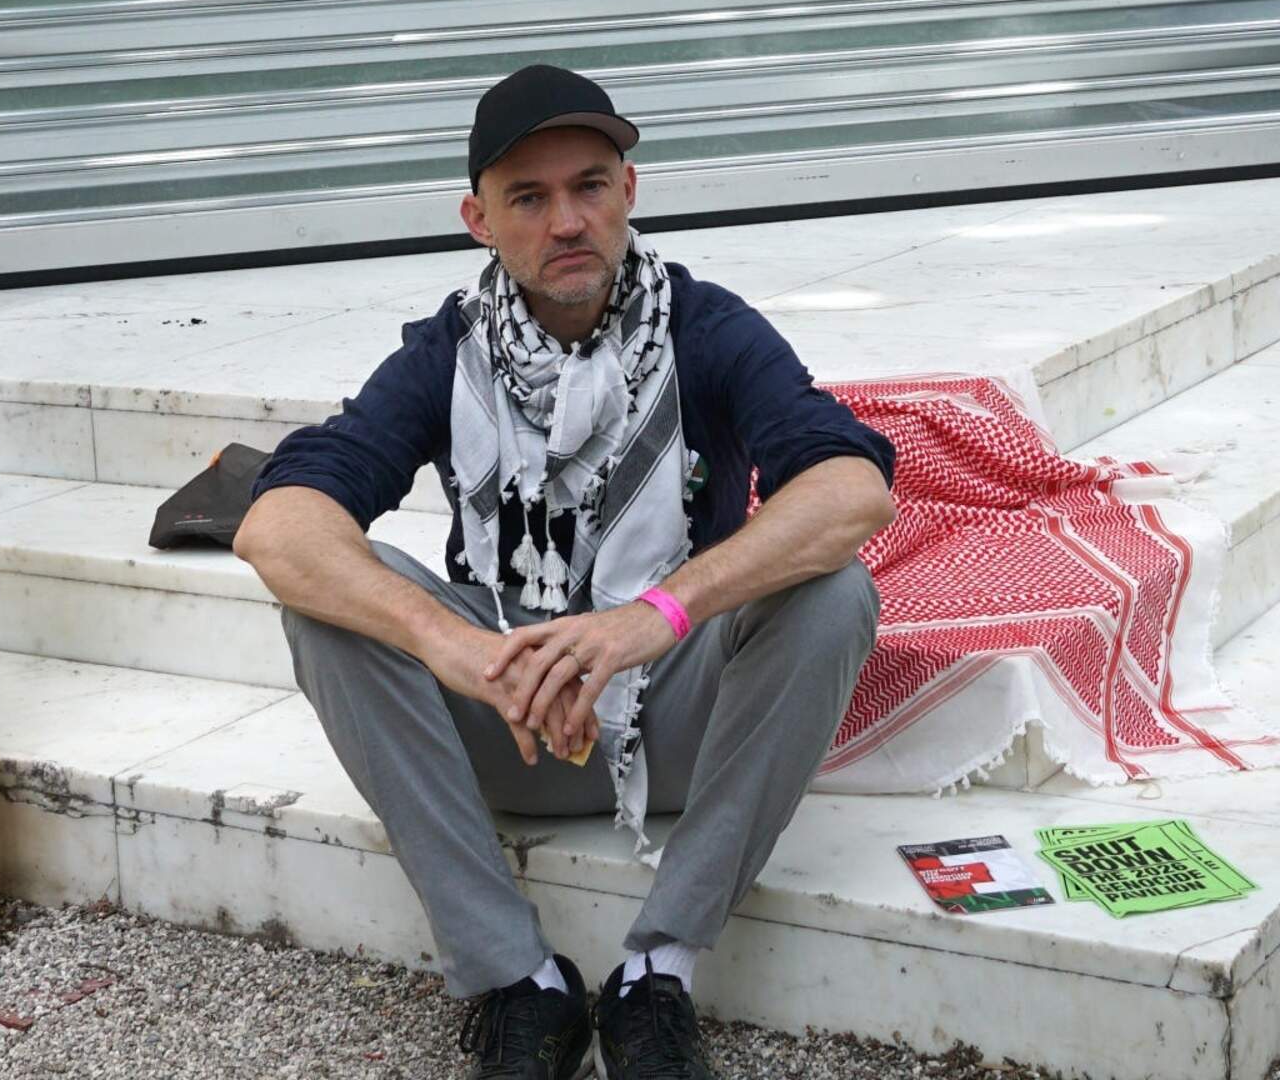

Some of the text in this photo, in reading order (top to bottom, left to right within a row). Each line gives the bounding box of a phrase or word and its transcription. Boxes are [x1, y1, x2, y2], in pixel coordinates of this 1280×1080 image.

[1054, 836, 1143, 862] SHUT
[1066, 847, 1176, 875] DOWN
[1081, 862, 1188, 884] THE 2026
[1095, 869, 1206, 894] GENOCIDE
[1105, 880, 1207, 903] PAVILION
